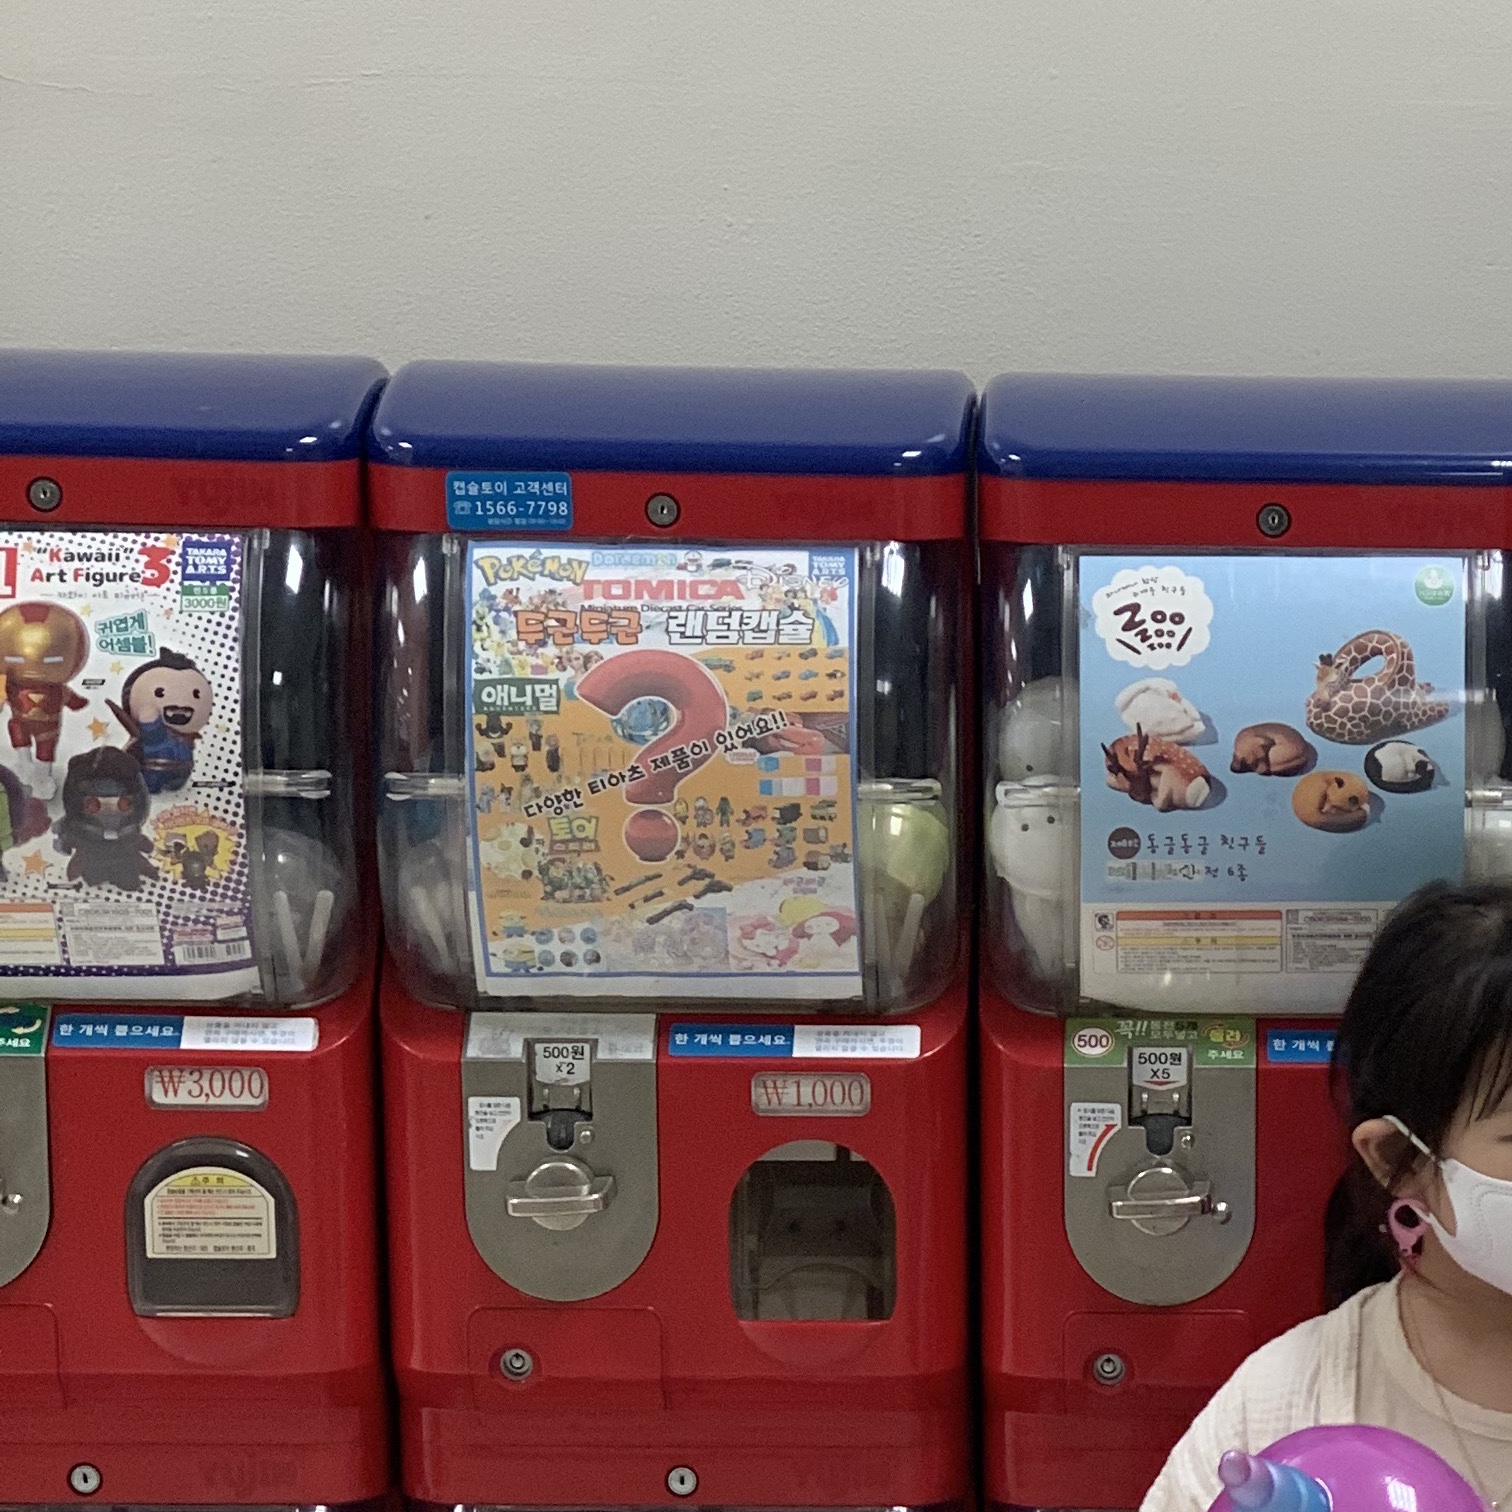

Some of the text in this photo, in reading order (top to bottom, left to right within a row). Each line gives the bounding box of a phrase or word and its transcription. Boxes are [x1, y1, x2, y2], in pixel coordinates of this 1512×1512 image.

[452, 480, 569, 497] 캡슐토이 고객센터
[474, 500, 569, 516] 1566-7798
[185, 547, 228, 557] TAKARA
[30, 567, 67, 583] Art
[72, 567, 142, 588] Figure
[138, 544, 174, 588] 3
[185, 556, 228, 566] TOMY
[812, 561, 847, 569] TOMY
[582, 578, 746, 601] TOMICA
[183, 595, 228, 609] 3000원
[98, 610, 147, 635] 귀엽게
[515, 608, 817, 646] 두근두근 랜덤캡슐
[98, 635, 154, 655] 어셈블!
[480, 683, 560, 708] 애니멀
[522, 709, 789, 819] 다양한 티아츠 제품이 있어요!!
[58, 1023, 74, 1037] 한
[79, 1023, 109, 1037] 개씩
[674, 1032, 688, 1047] 한
[694, 1032, 724, 1047] 개씩
[1076, 1034, 1110, 1048] 500
[1272, 1038, 1320, 1052] 한 개씩
[543, 1045, 585, 1061] 500원
[1137, 1052, 1183, 1067] 500원
